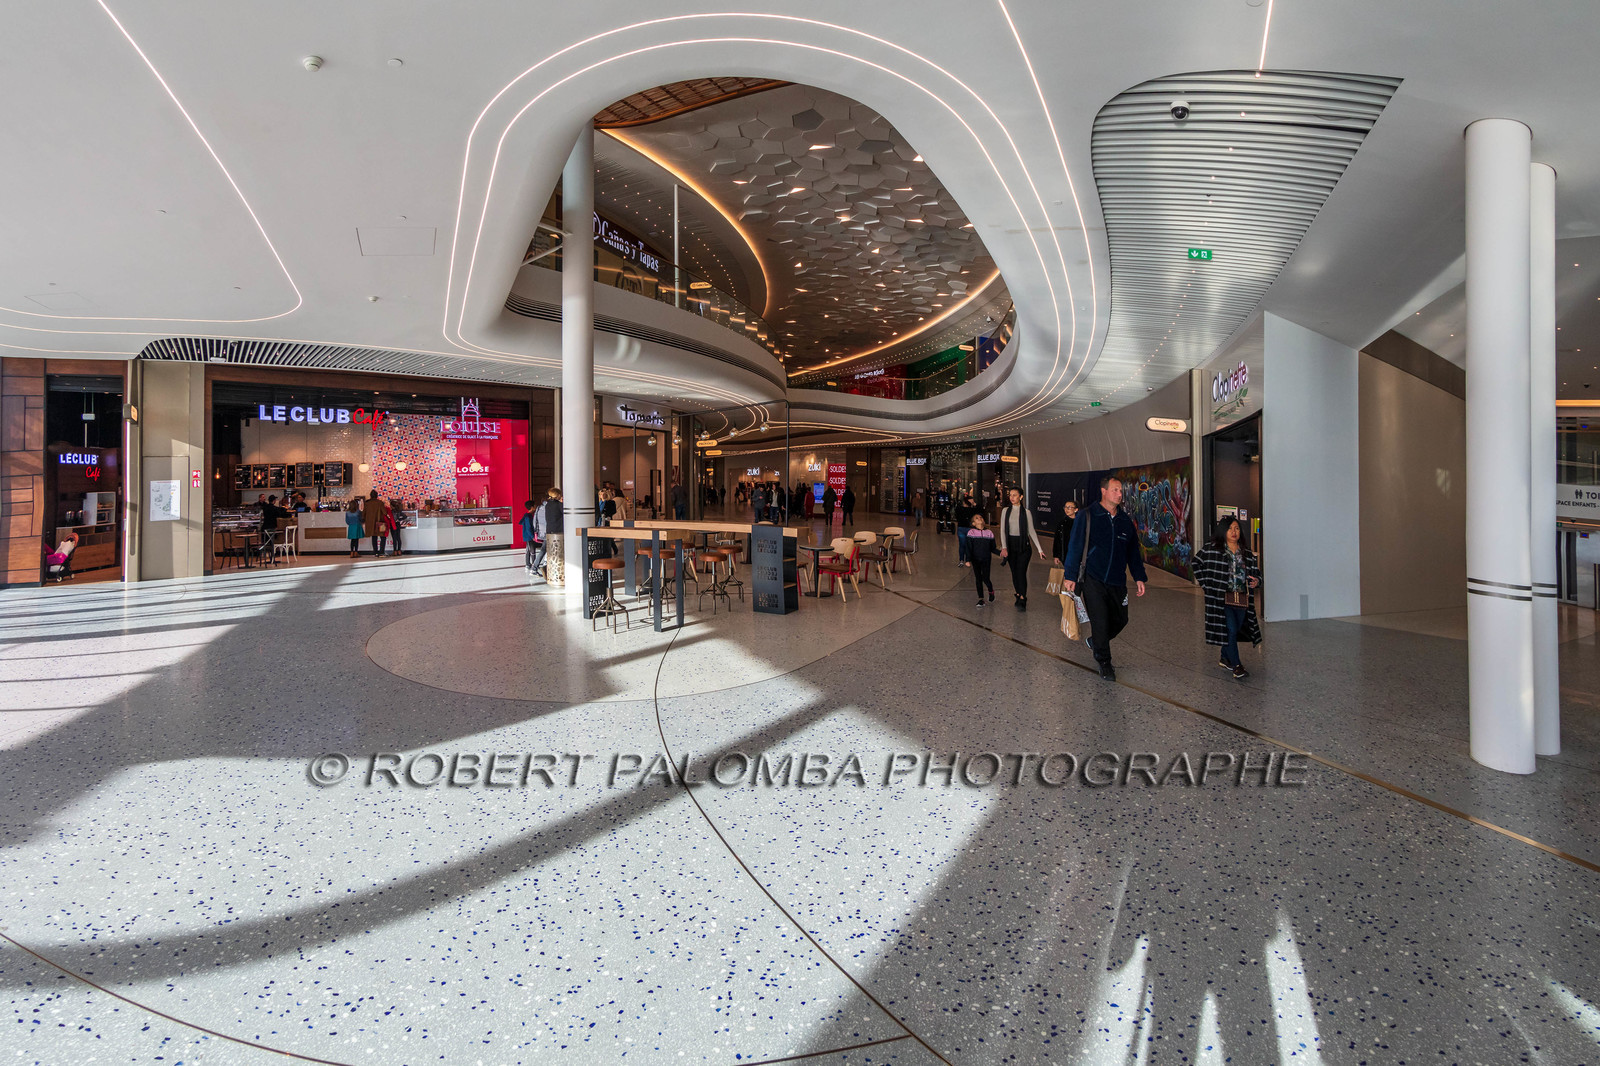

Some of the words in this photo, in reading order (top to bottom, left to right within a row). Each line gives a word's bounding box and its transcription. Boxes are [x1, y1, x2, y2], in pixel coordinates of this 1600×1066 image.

[638, 240, 659, 272] Tapas
[1212, 360, 1248, 402] Clopinette
[352, 407, 386, 431] Café
[1154, 419, 1180, 428] Clopinette
[440, 420, 501, 433] LOUISE
[1585, 491, 1600, 500] TOI
[1572, 501, 1597, 509] ENFANTS
